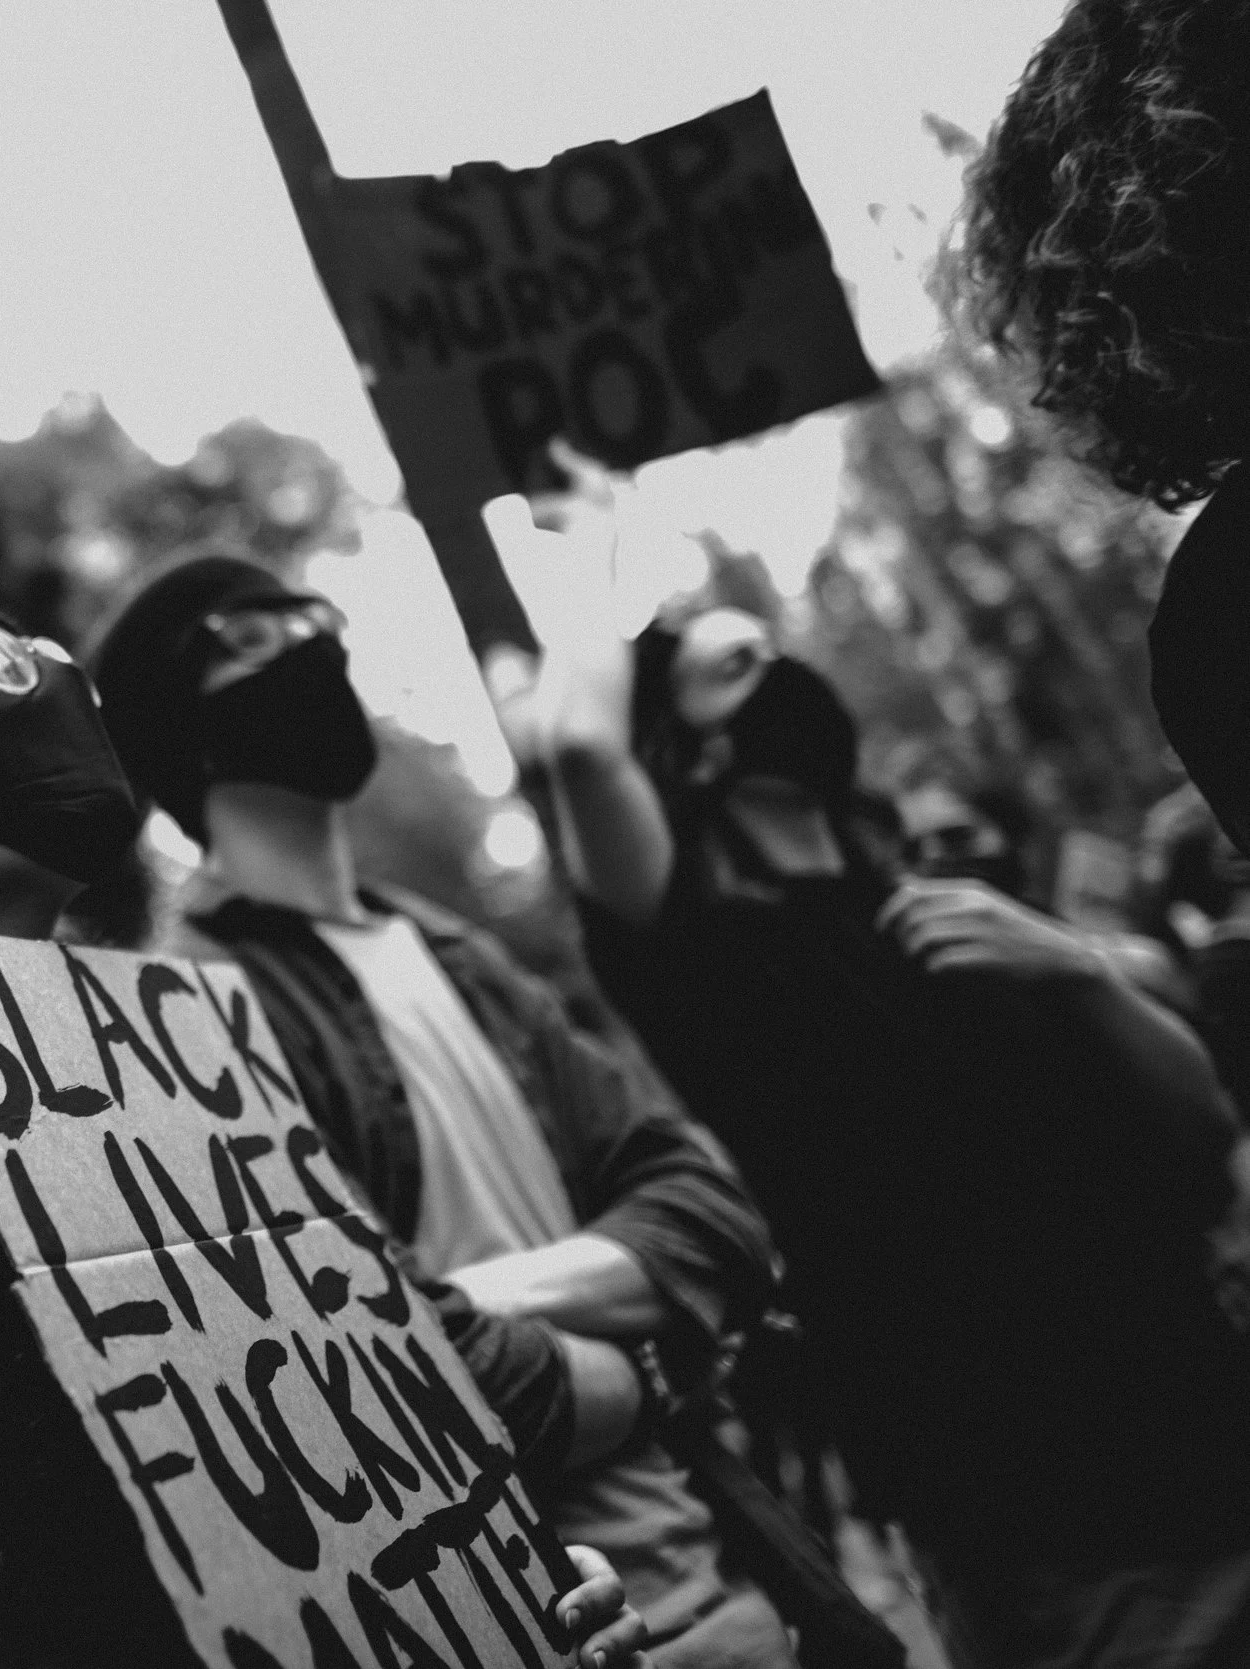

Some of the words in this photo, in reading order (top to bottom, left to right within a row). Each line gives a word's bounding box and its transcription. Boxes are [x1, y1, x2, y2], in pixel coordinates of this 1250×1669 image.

[413, 116, 735, 280] STOP
[477, 292, 782, 490] POC
[4, 1124, 410, 1358] LIVES
[94, 1330, 505, 1597] FUCKIN
